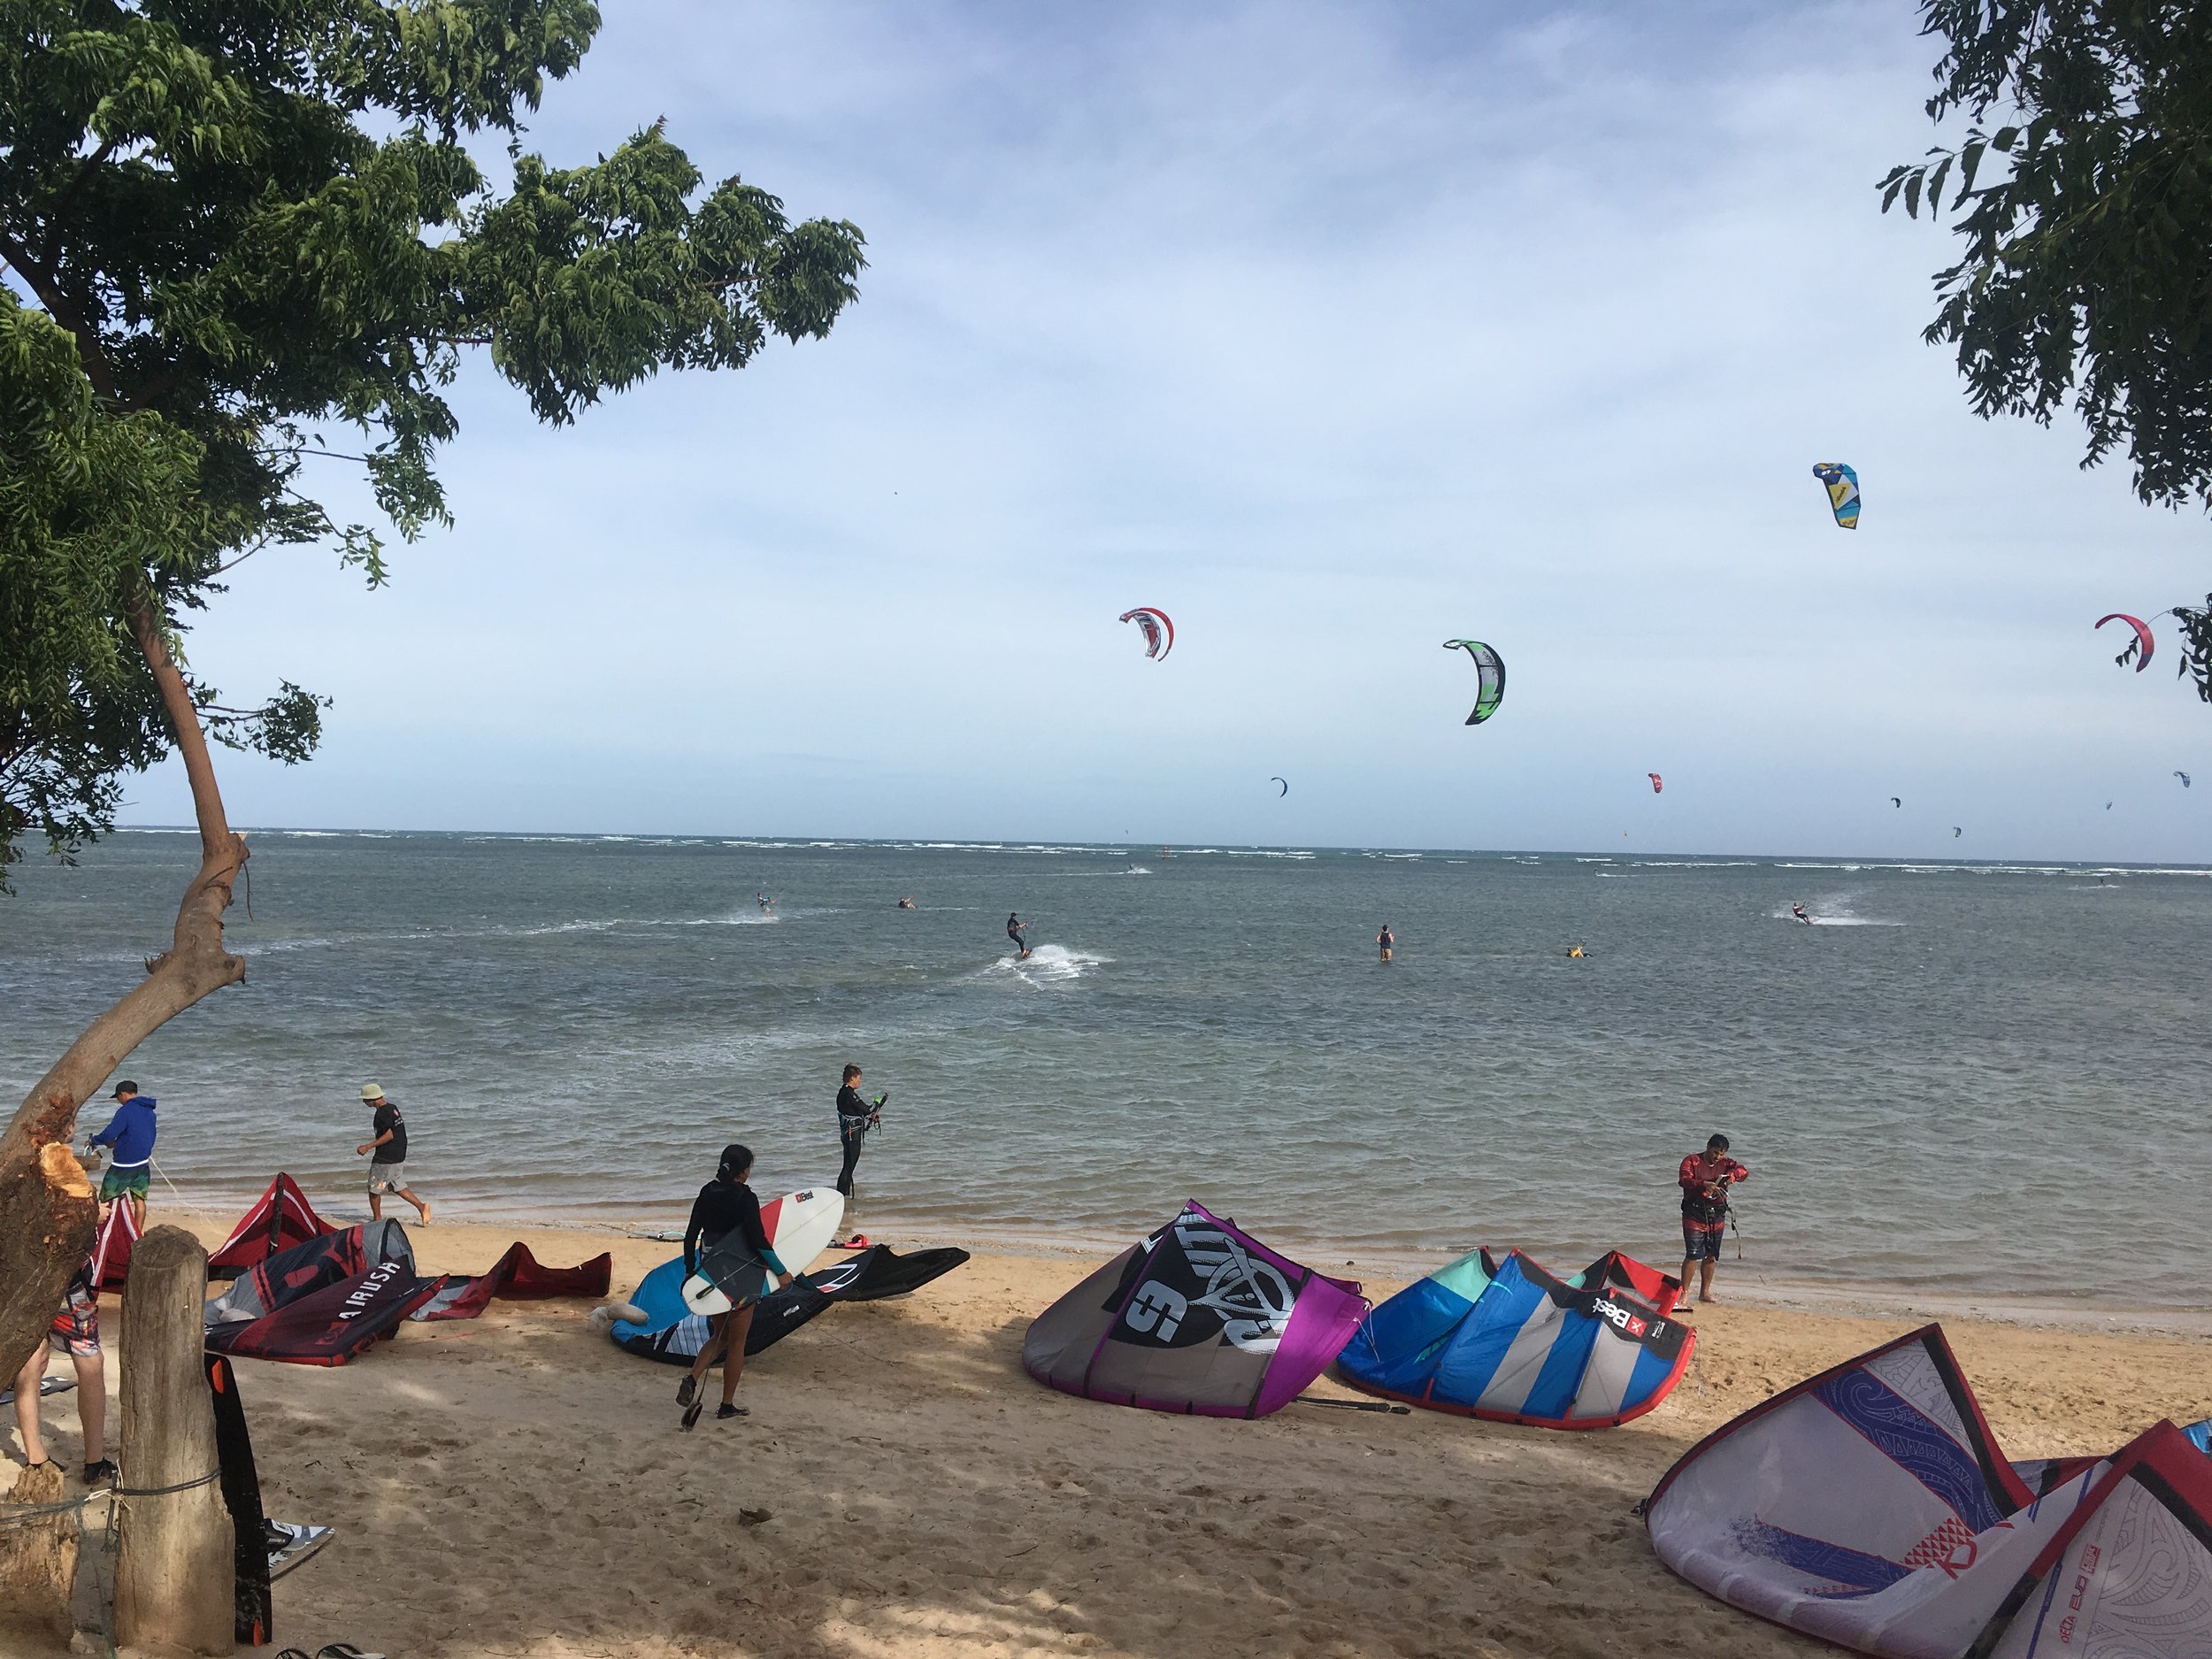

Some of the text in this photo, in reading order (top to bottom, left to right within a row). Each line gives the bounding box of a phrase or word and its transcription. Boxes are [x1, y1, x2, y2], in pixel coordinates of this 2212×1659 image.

[801, 1189, 814, 1202] Best
[338, 1262, 401, 1320] AIRUSH
[1592, 1297, 1632, 1329] Best
[2060, 1615, 2077, 1644] DELTA
